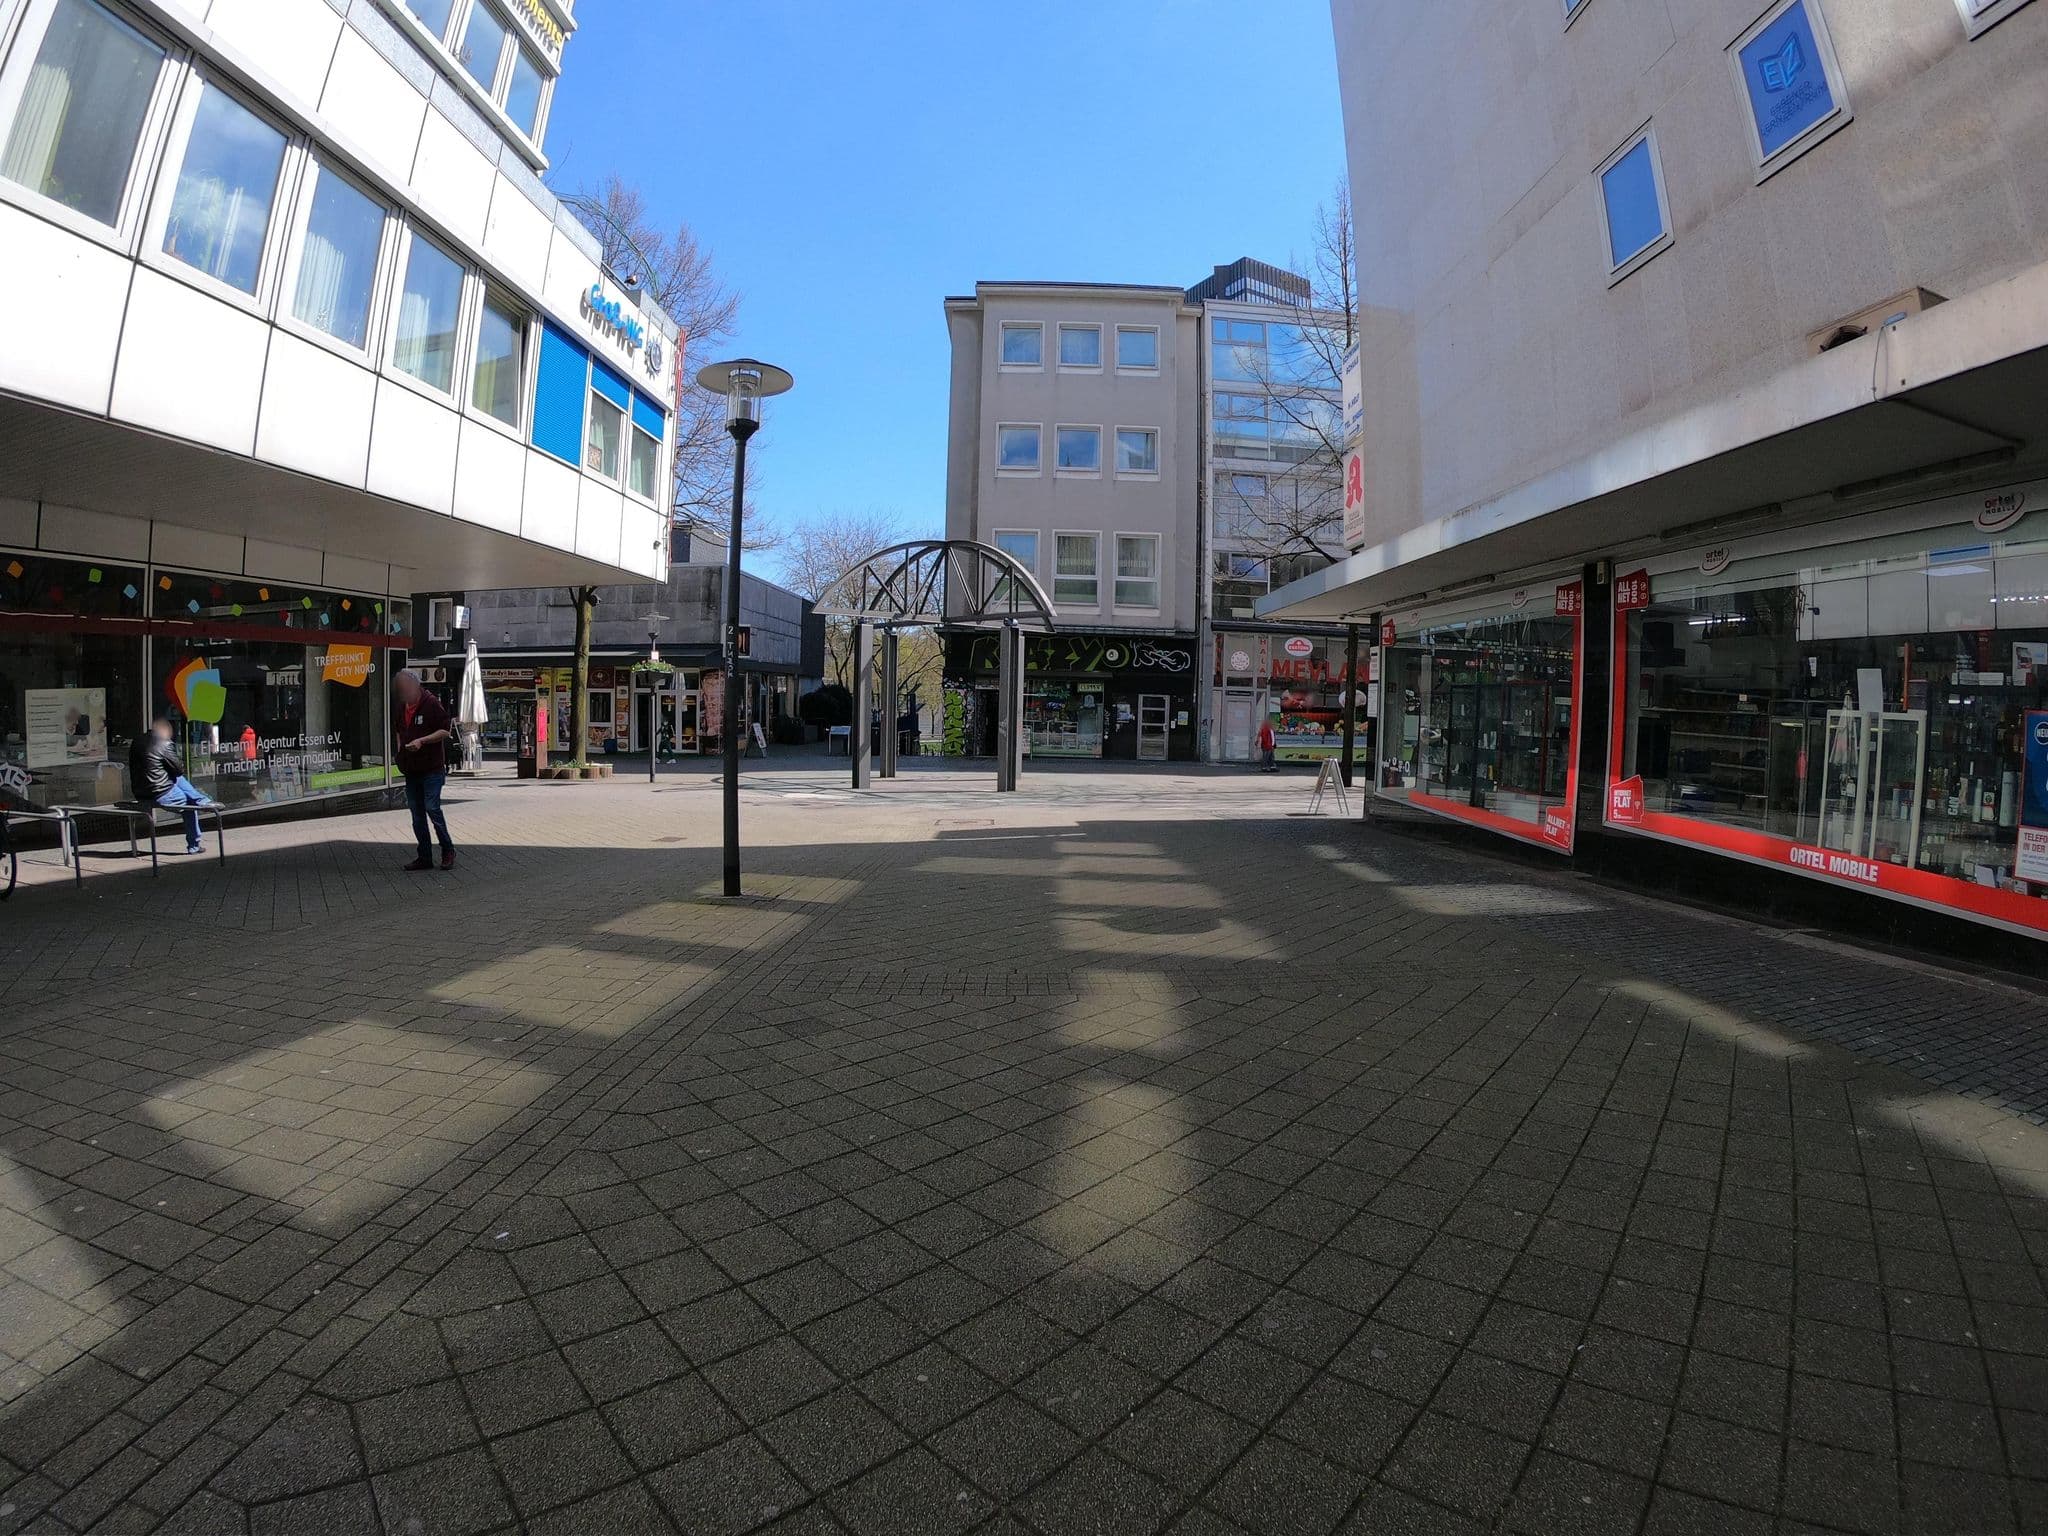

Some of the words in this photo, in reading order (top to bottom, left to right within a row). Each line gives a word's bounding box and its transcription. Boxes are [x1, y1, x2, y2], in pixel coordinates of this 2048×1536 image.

[1705, 547, 1724, 559] ortel
[1618, 580, 1630, 592] ALL
[1558, 590, 1568, 600] ALL
[1617, 592, 1630, 604] NET
[1557, 599, 1567, 610] NET
[314, 652, 365, 667] TREFFPUNKT
[336, 665, 352, 677] CITY
[355, 663, 376, 675] NORD
[201, 739, 254, 755] Ehrenamt
[257, 735, 297, 753] Agentur
[299, 732, 325, 746] Essen
[327, 731, 342, 744] e.V.
[201, 760, 220, 776] Wir
[224, 757, 266, 775] machen
[268, 753, 301, 768] Helfen
[303, 748, 342, 767] möglich!
[1614, 796, 1632, 808] FLAT
[1545, 824, 1558, 836] FLAT
[2032, 844, 2046, 853] DER
[1789, 847, 1826, 870] ORTEL
[1829, 855, 1879, 883] MOBILE
